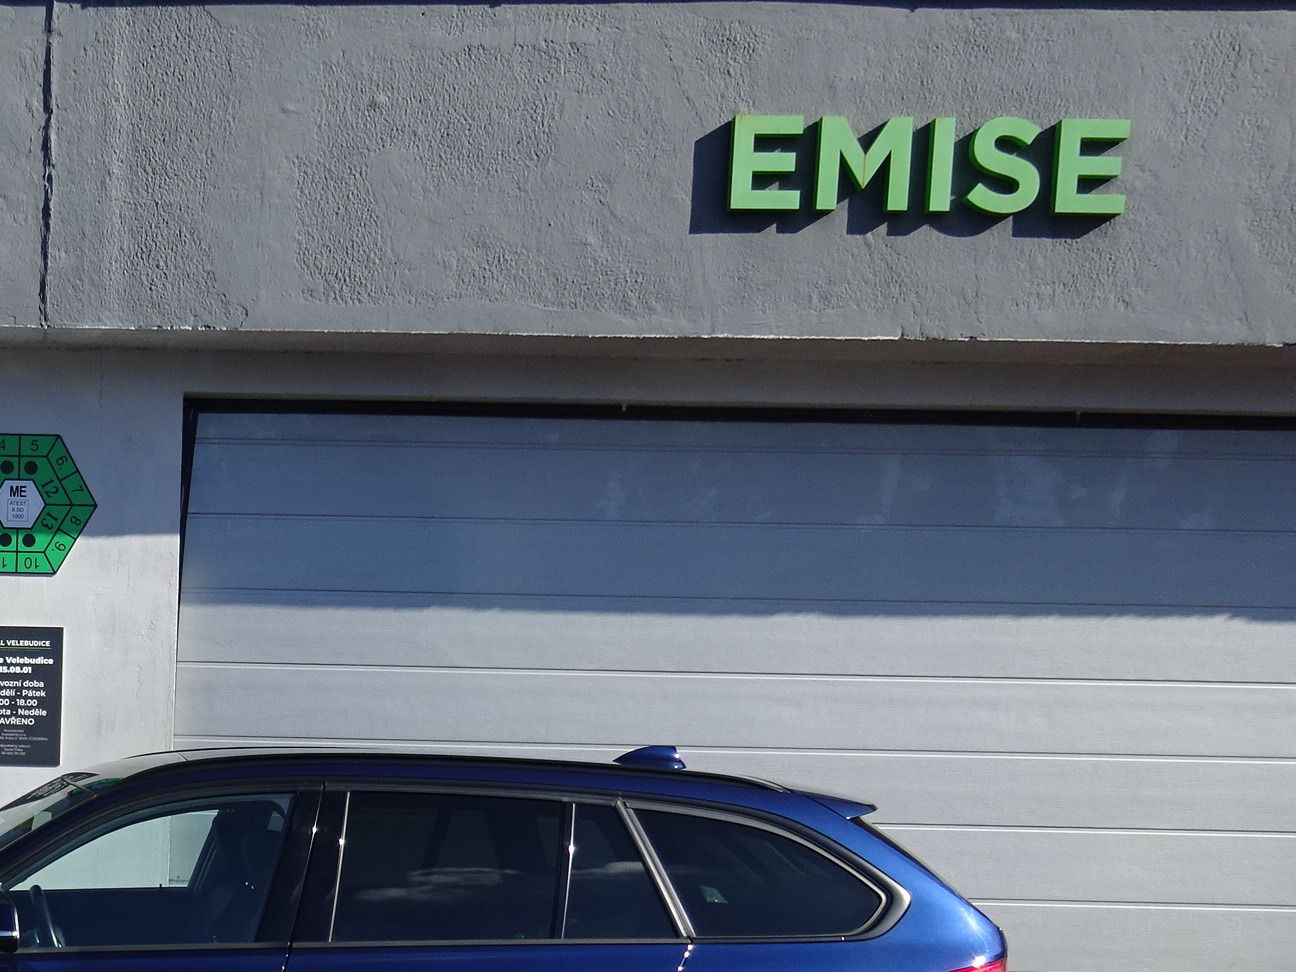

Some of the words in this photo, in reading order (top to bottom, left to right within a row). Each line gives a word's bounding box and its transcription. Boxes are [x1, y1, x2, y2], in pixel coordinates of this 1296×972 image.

[728, 114, 1132, 216] EMISE
[30, 439, 39, 452] 5
[9, 485, 28, 498] ME
[41, 479, 59, 498] 12
[72, 485, 84, 494] 7
[41, 512, 58, 531] 13
[70, 516, 82, 526] 8
[24, 556, 40, 569] 10
[6, 639, 51, 648] VELEBUDICE
[5, 656, 54, 665] Velebudice
[23, 680, 45, 688] doba
[22, 689, 47, 698] Pátek
[16, 698, 38, 706] 18.00
[17, 708, 47, 717] Neděle
